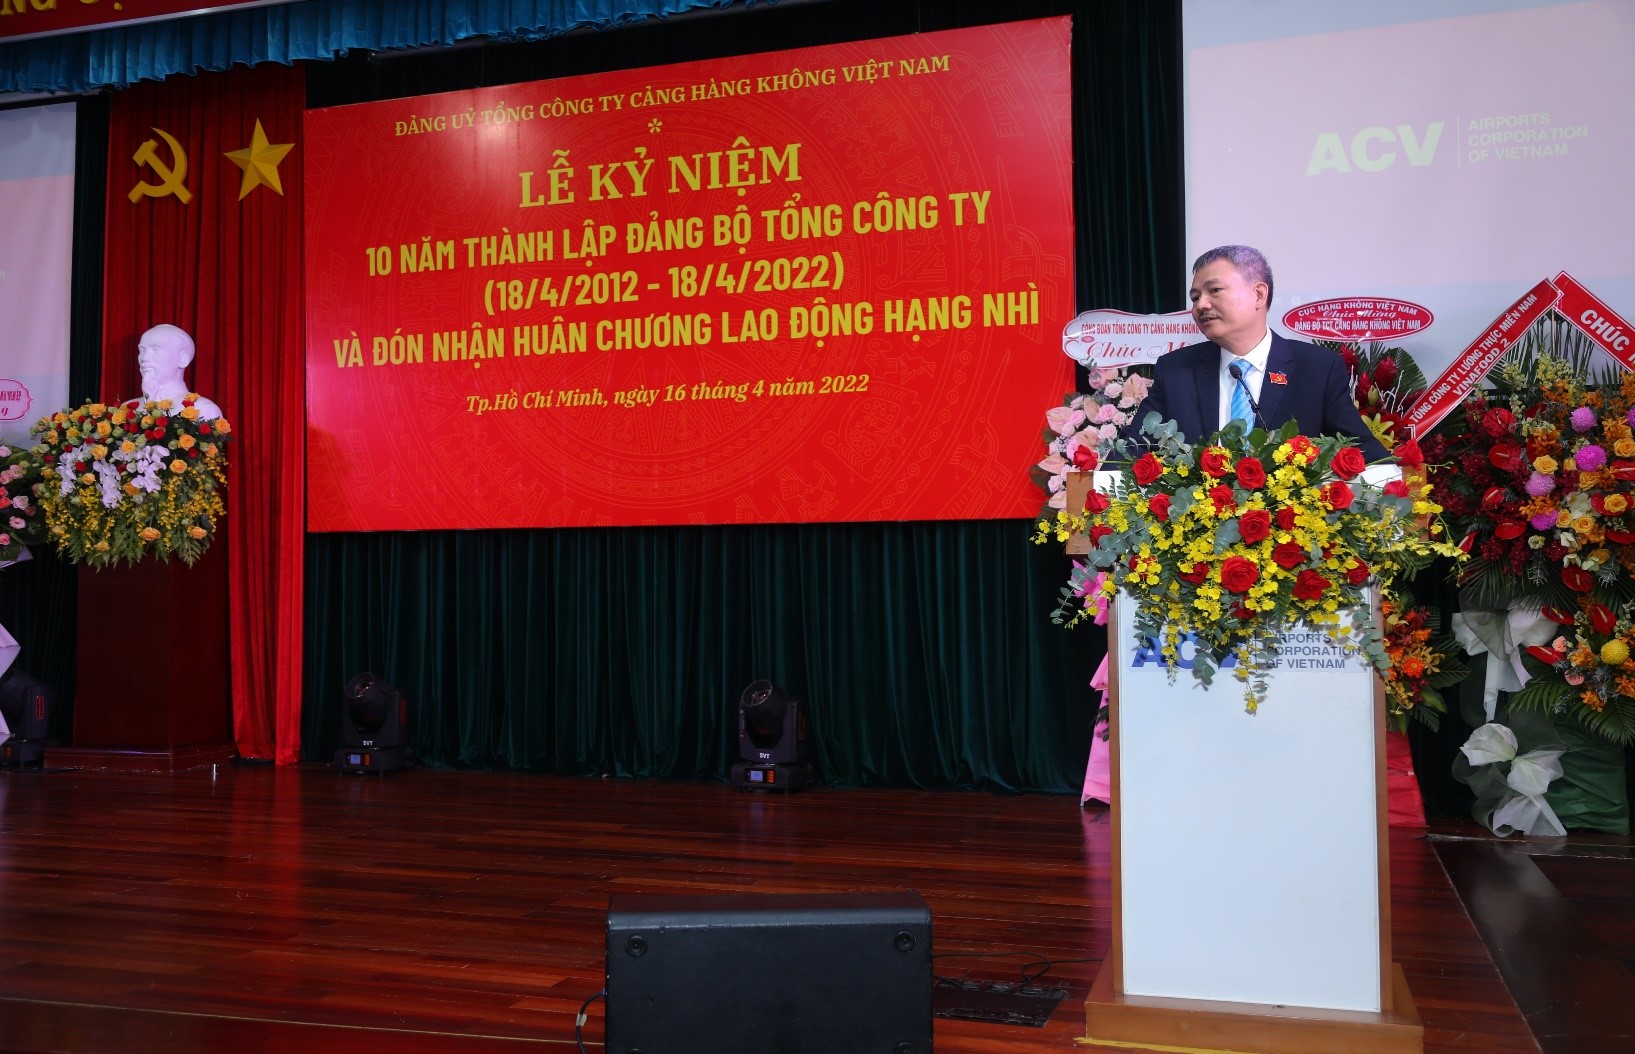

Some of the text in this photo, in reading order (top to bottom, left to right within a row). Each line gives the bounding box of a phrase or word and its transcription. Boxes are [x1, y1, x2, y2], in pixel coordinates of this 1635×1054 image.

[395, 55, 950, 136] ĐẢNG UỶ TỔNG CÔNG TY CẢNG HÀNG KHÔNG VIỆT NAM
[1468, 112, 1551, 131] AIRPORTS
[1468, 125, 1589, 147] CORPORATION
[1305, 122, 1445, 177] ACV
[1468, 144, 1568, 164] OF VIETNAM
[519, 136, 802, 208] LỄ KỶ NIỆM
[366, 190, 992, 277] 10 NĂM THÀNH LẬP ĐẢNG BỘ TỔNG CÔNG TY
[484, 270, 639, 316] (18/4/2012
[668, 251, 844, 298] 18/4/2022)
[333, 282, 1039, 369] VÀ ĐÓN NHẬN HUÂN CHƯƠNG LAO ĐỘNG HẠNG NHÌ
[1127, 320, 1141, 334] CÔNG
[1143, 324, 1150, 334] TY
[1298, 300, 1418, 316] CỤC HÀNG KHÔNG VIỆT NAM
[1391, 317, 1406, 331] VIỆT
[1407, 320, 1420, 330] NAM
[1087, 341, 1141, 358] Chúc
[1581, 309, 1630, 351] CHÚC
[1409, 293, 1537, 423] TỔNG CÔNG TY LƯƠNG THỰC MIỀN NAM
[1452, 338, 1511, 396] VINAFOOD 2
[467, 374, 870, 415] Tp.Hồ Chí Minh, ngày 16 tháng 4 năm 2022
[1266, 659, 1345, 668] OF VIETNAM
[1274, 646, 1361, 656] ORPORATION
